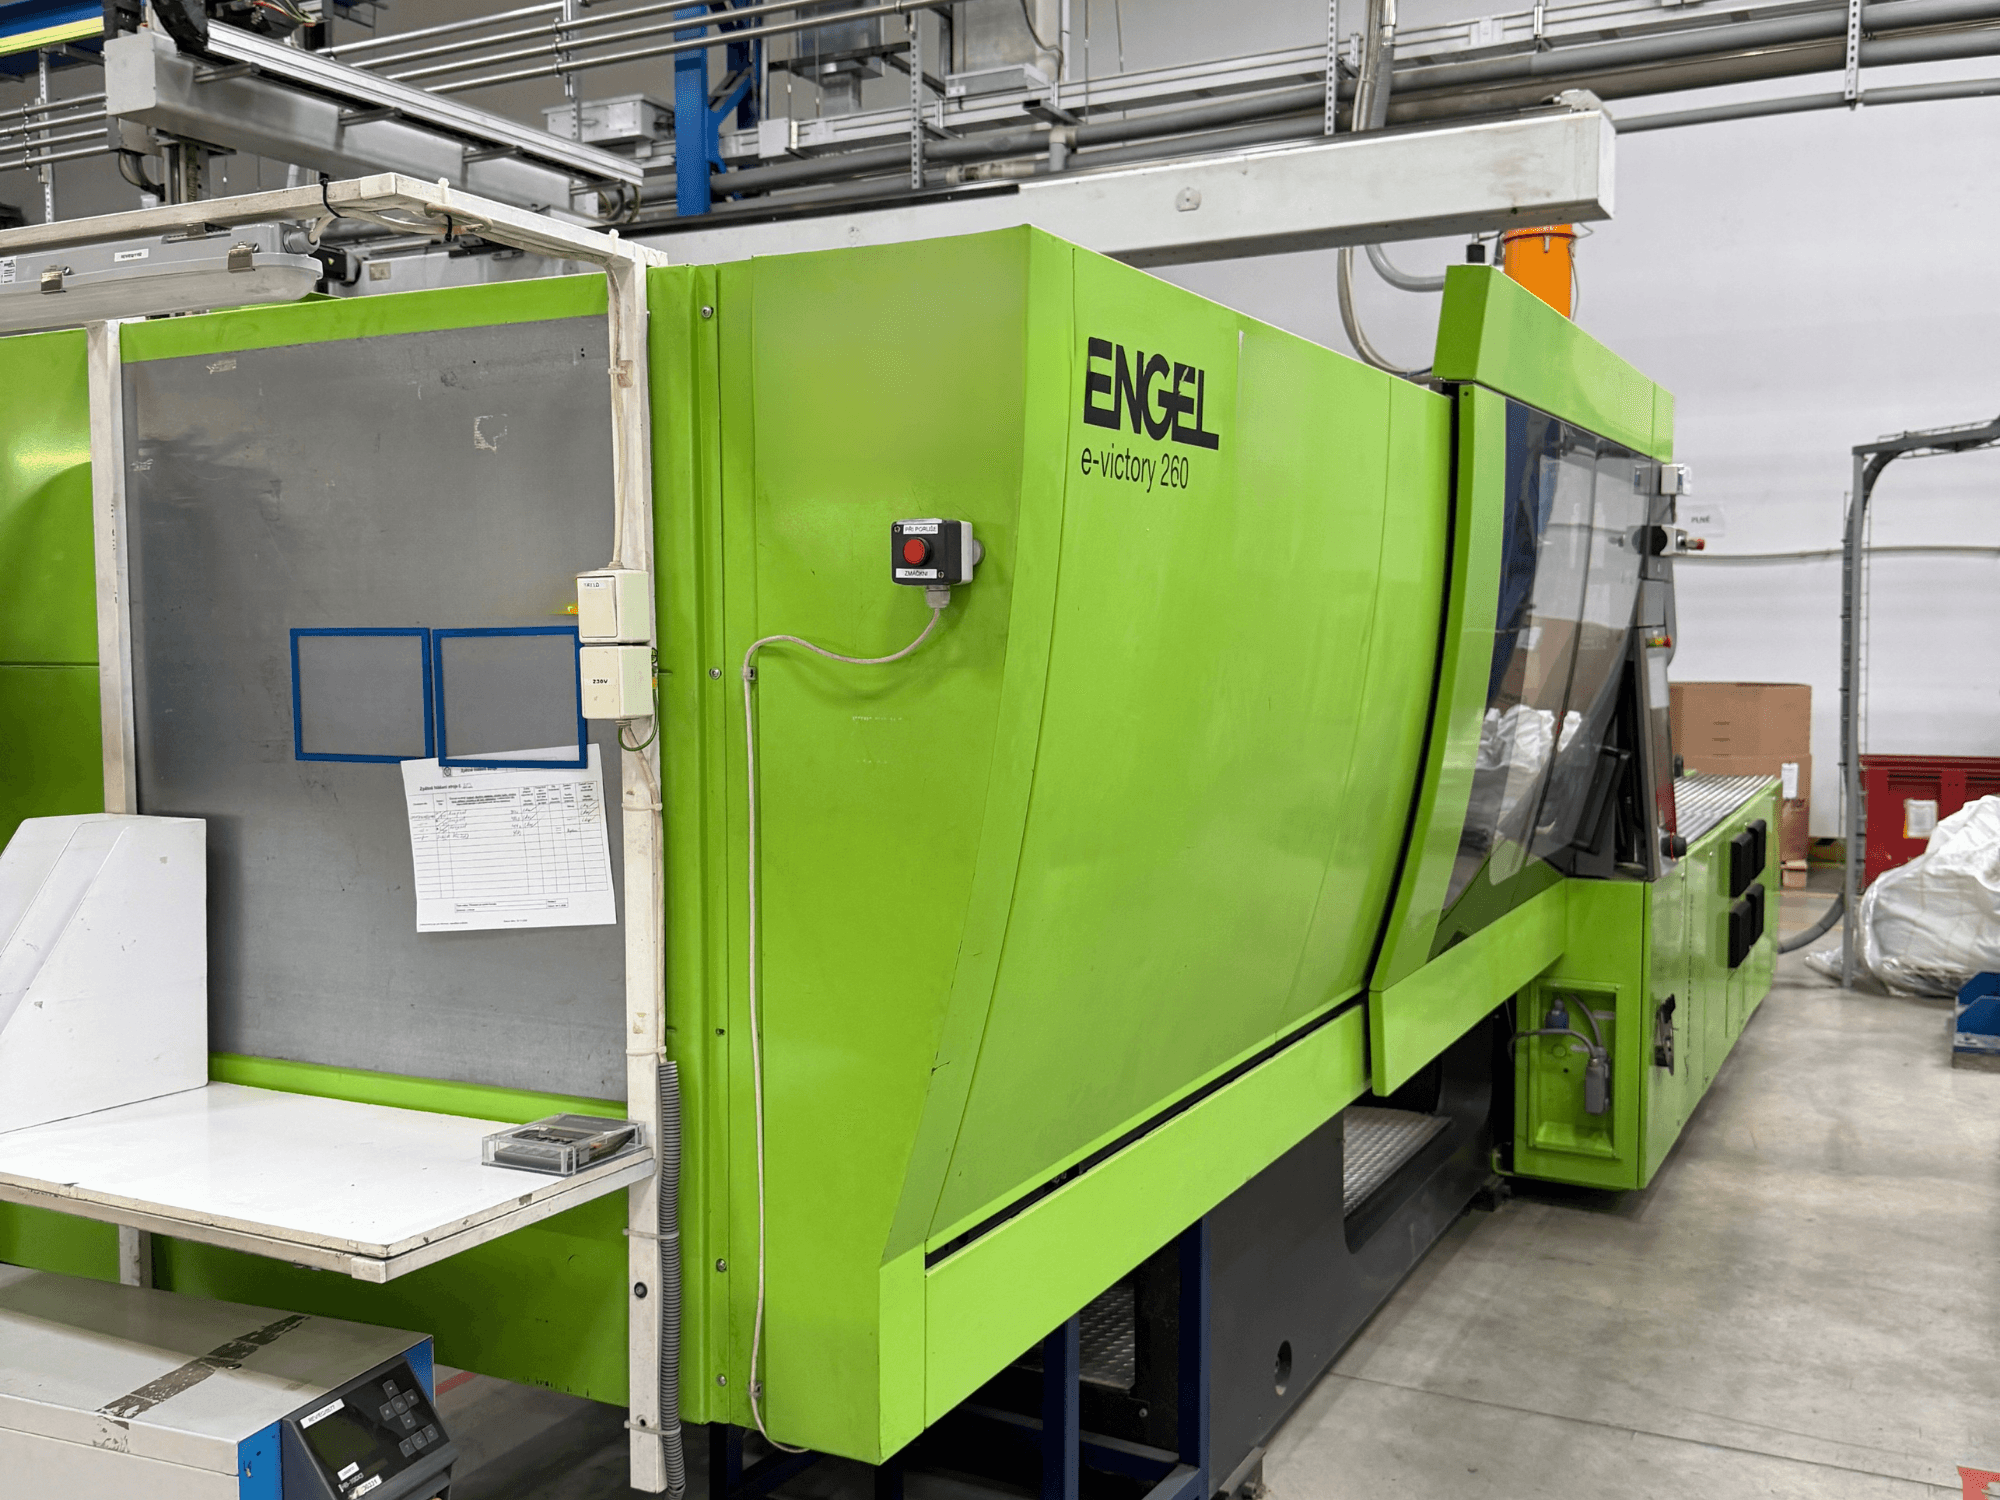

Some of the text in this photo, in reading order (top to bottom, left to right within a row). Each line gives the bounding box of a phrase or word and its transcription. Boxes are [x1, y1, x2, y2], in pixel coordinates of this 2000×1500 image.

[1084, 337, 1219, 451] ENGEL
[1081, 443, 1189, 493] e-victory 260
